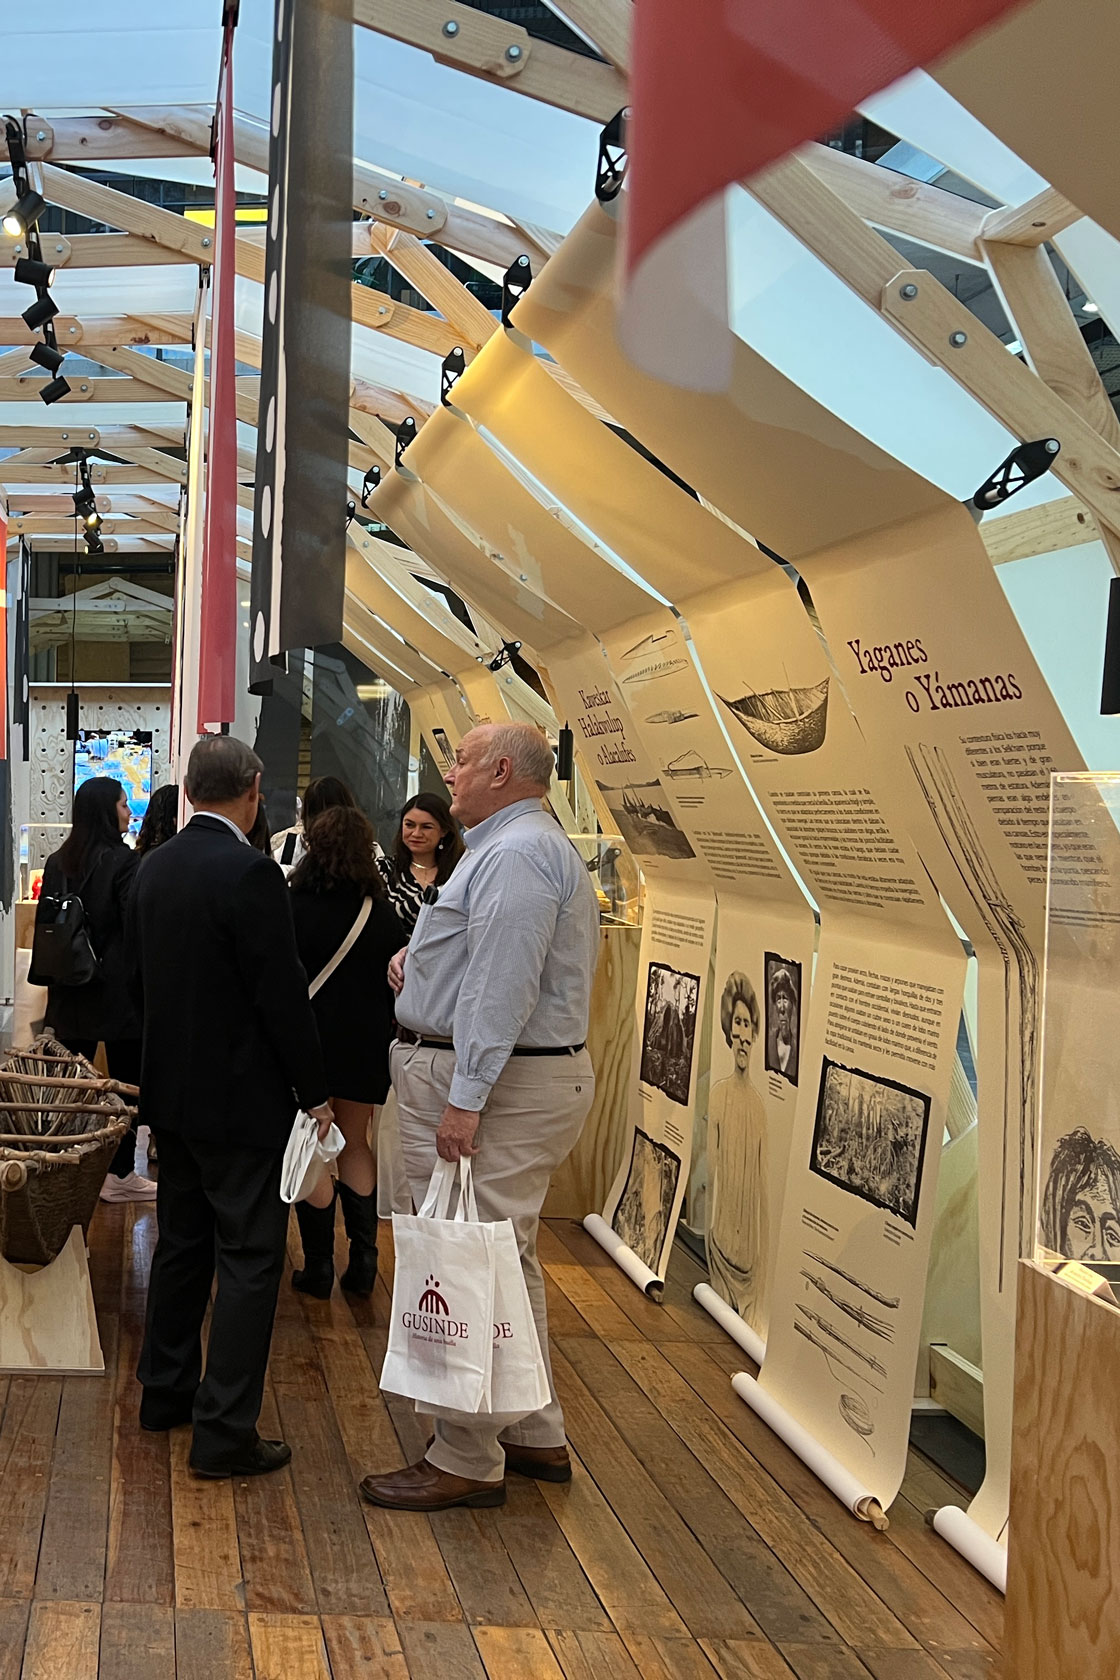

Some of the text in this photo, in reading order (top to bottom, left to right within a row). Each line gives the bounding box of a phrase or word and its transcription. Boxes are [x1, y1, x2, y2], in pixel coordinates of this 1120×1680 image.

[847, 638, 928, 683] Yaganes
[905, 671, 1023, 713] o Yámanas
[578, 710, 626, 740] Halakwulup
[597, 741, 637, 765] o Alacalufes
[1002, 757, 1021, 765] fuertes
[1039, 756, 1053, 765] gran
[402, 1312, 469, 1339] GUSINDE
